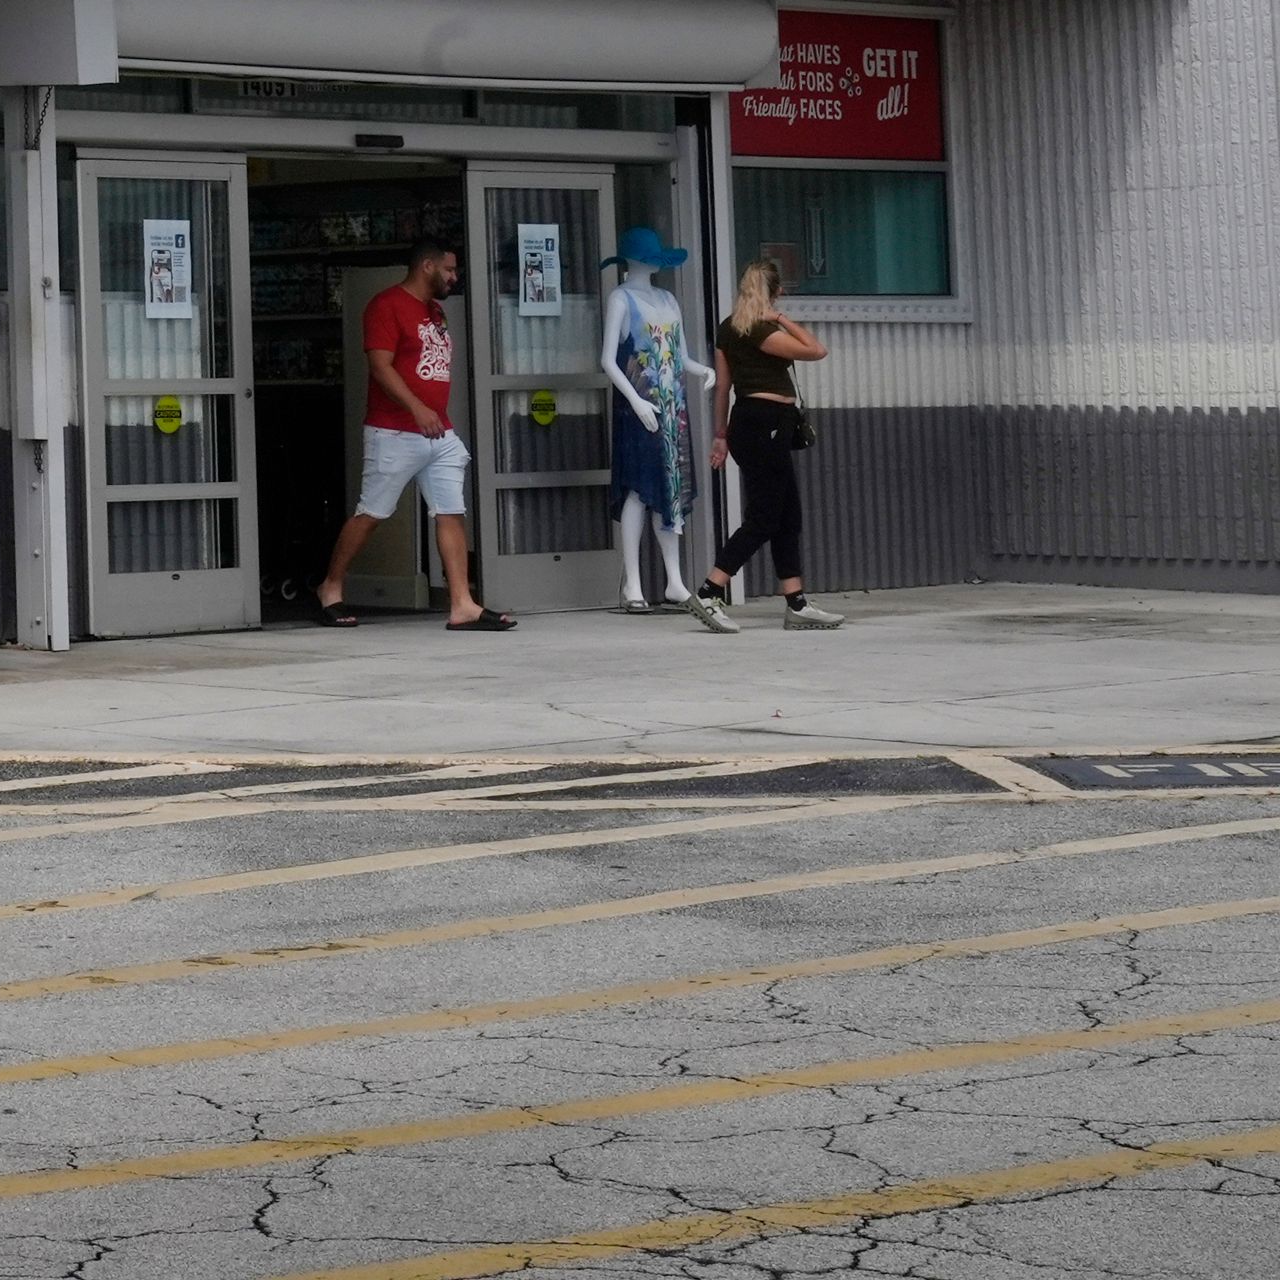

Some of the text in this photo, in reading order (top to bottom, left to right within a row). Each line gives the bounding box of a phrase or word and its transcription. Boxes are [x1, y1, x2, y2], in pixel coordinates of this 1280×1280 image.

[797, 43, 841, 65] HAVES
[862, 47, 919, 80] GET IT
[799, 72, 835, 93] FORS
[742, 95, 843, 126] Friendly FACES
[877, 83, 910, 121] all!
